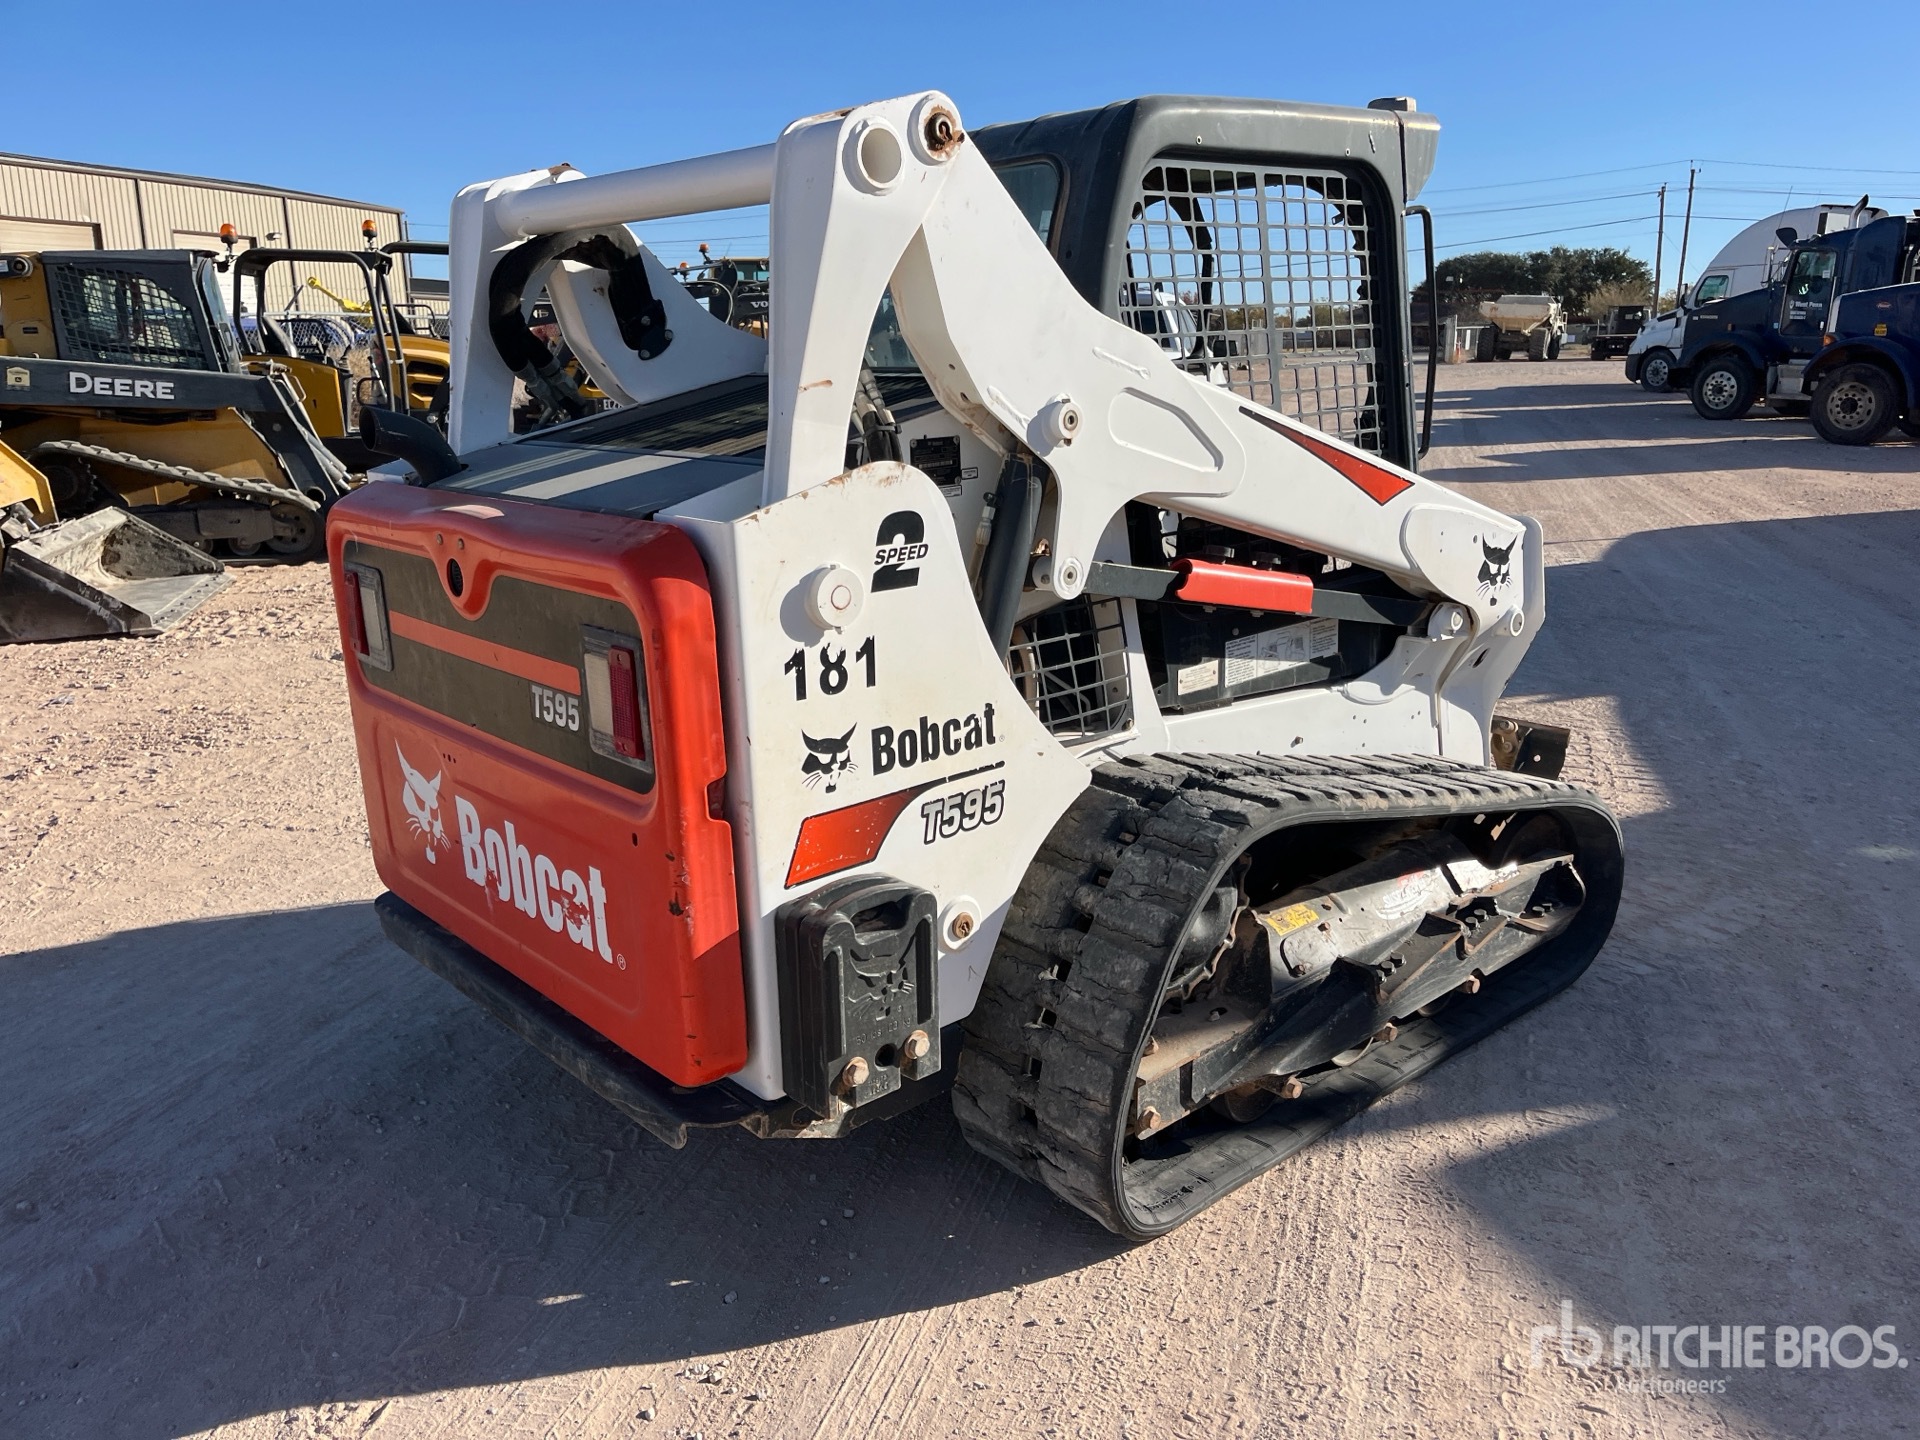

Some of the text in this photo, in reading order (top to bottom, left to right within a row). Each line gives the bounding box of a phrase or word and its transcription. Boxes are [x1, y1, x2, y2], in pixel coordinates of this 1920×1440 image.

[69, 371, 175, 399] DEERE
[871, 510, 925, 593] 2
[874, 543, 929, 565] SPEED
[784, 635, 876, 701] 181
[531, 684, 580, 732] T595
[871, 702, 996, 776] Bobcat
[921, 779, 1005, 845] T595
[455, 795, 613, 964] Bobcat
